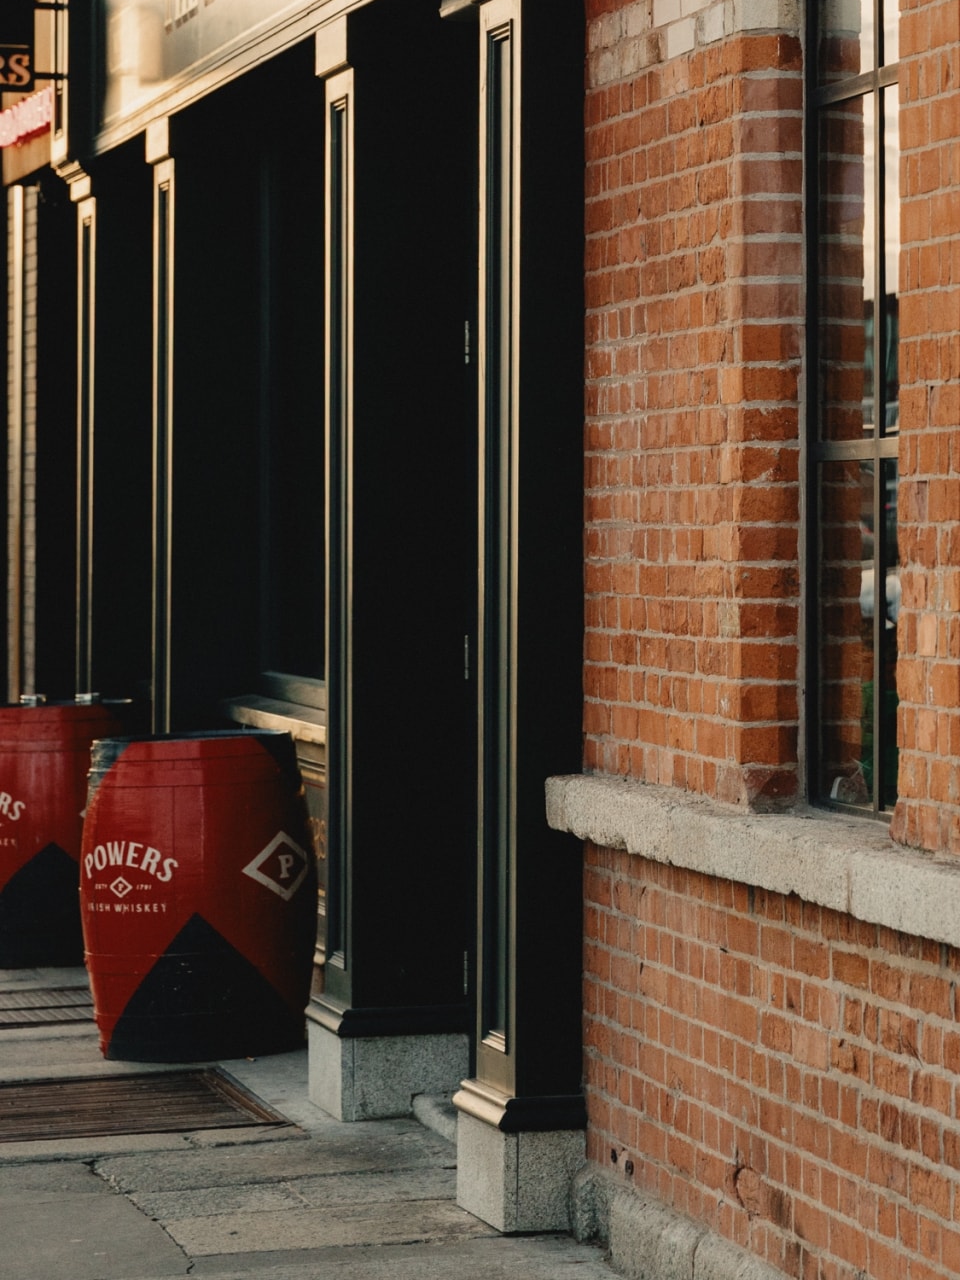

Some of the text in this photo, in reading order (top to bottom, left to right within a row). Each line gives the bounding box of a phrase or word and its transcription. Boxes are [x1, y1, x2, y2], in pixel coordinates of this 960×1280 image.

[84, 841, 179, 882] POWERS
[277, 854, 294, 879] P
[114, 903, 167, 913] WHISKEY
